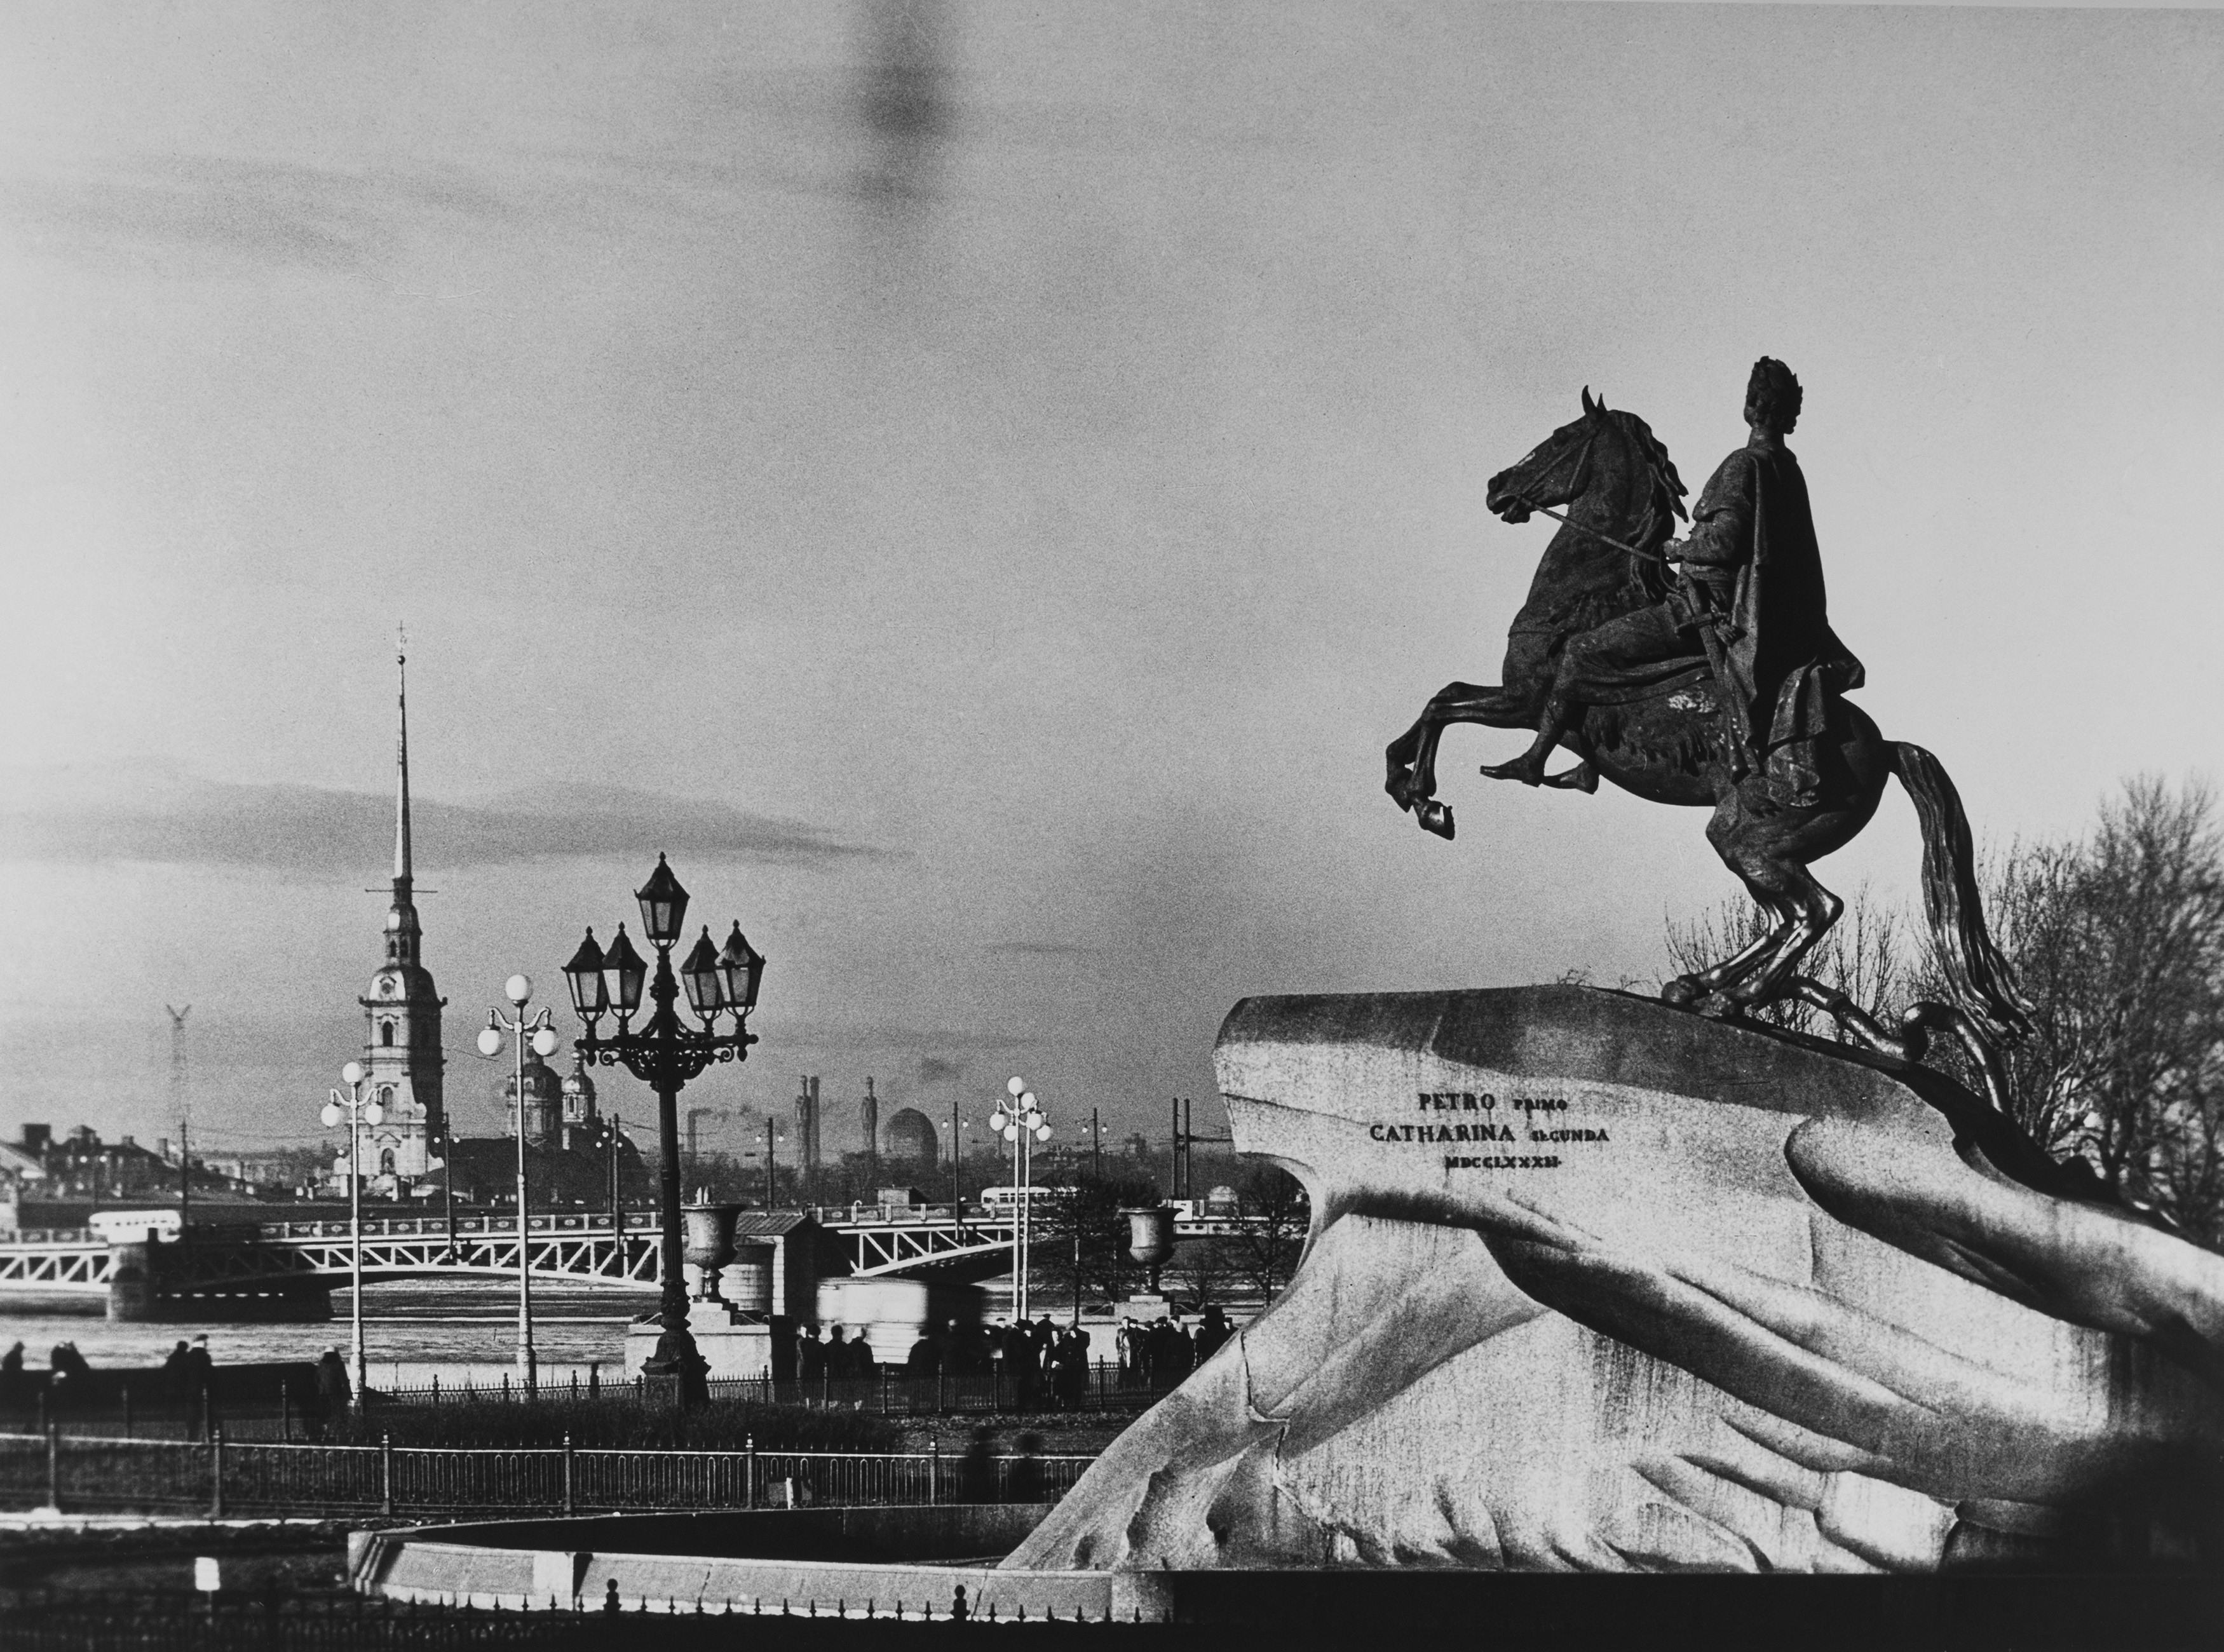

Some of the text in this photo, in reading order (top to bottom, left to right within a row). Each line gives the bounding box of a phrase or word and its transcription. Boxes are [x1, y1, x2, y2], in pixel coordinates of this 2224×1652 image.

[1418, 1093, 1568, 1111] PETRO PRIMO
[1370, 1125, 1610, 1142] CATHARINA SECUNDA
